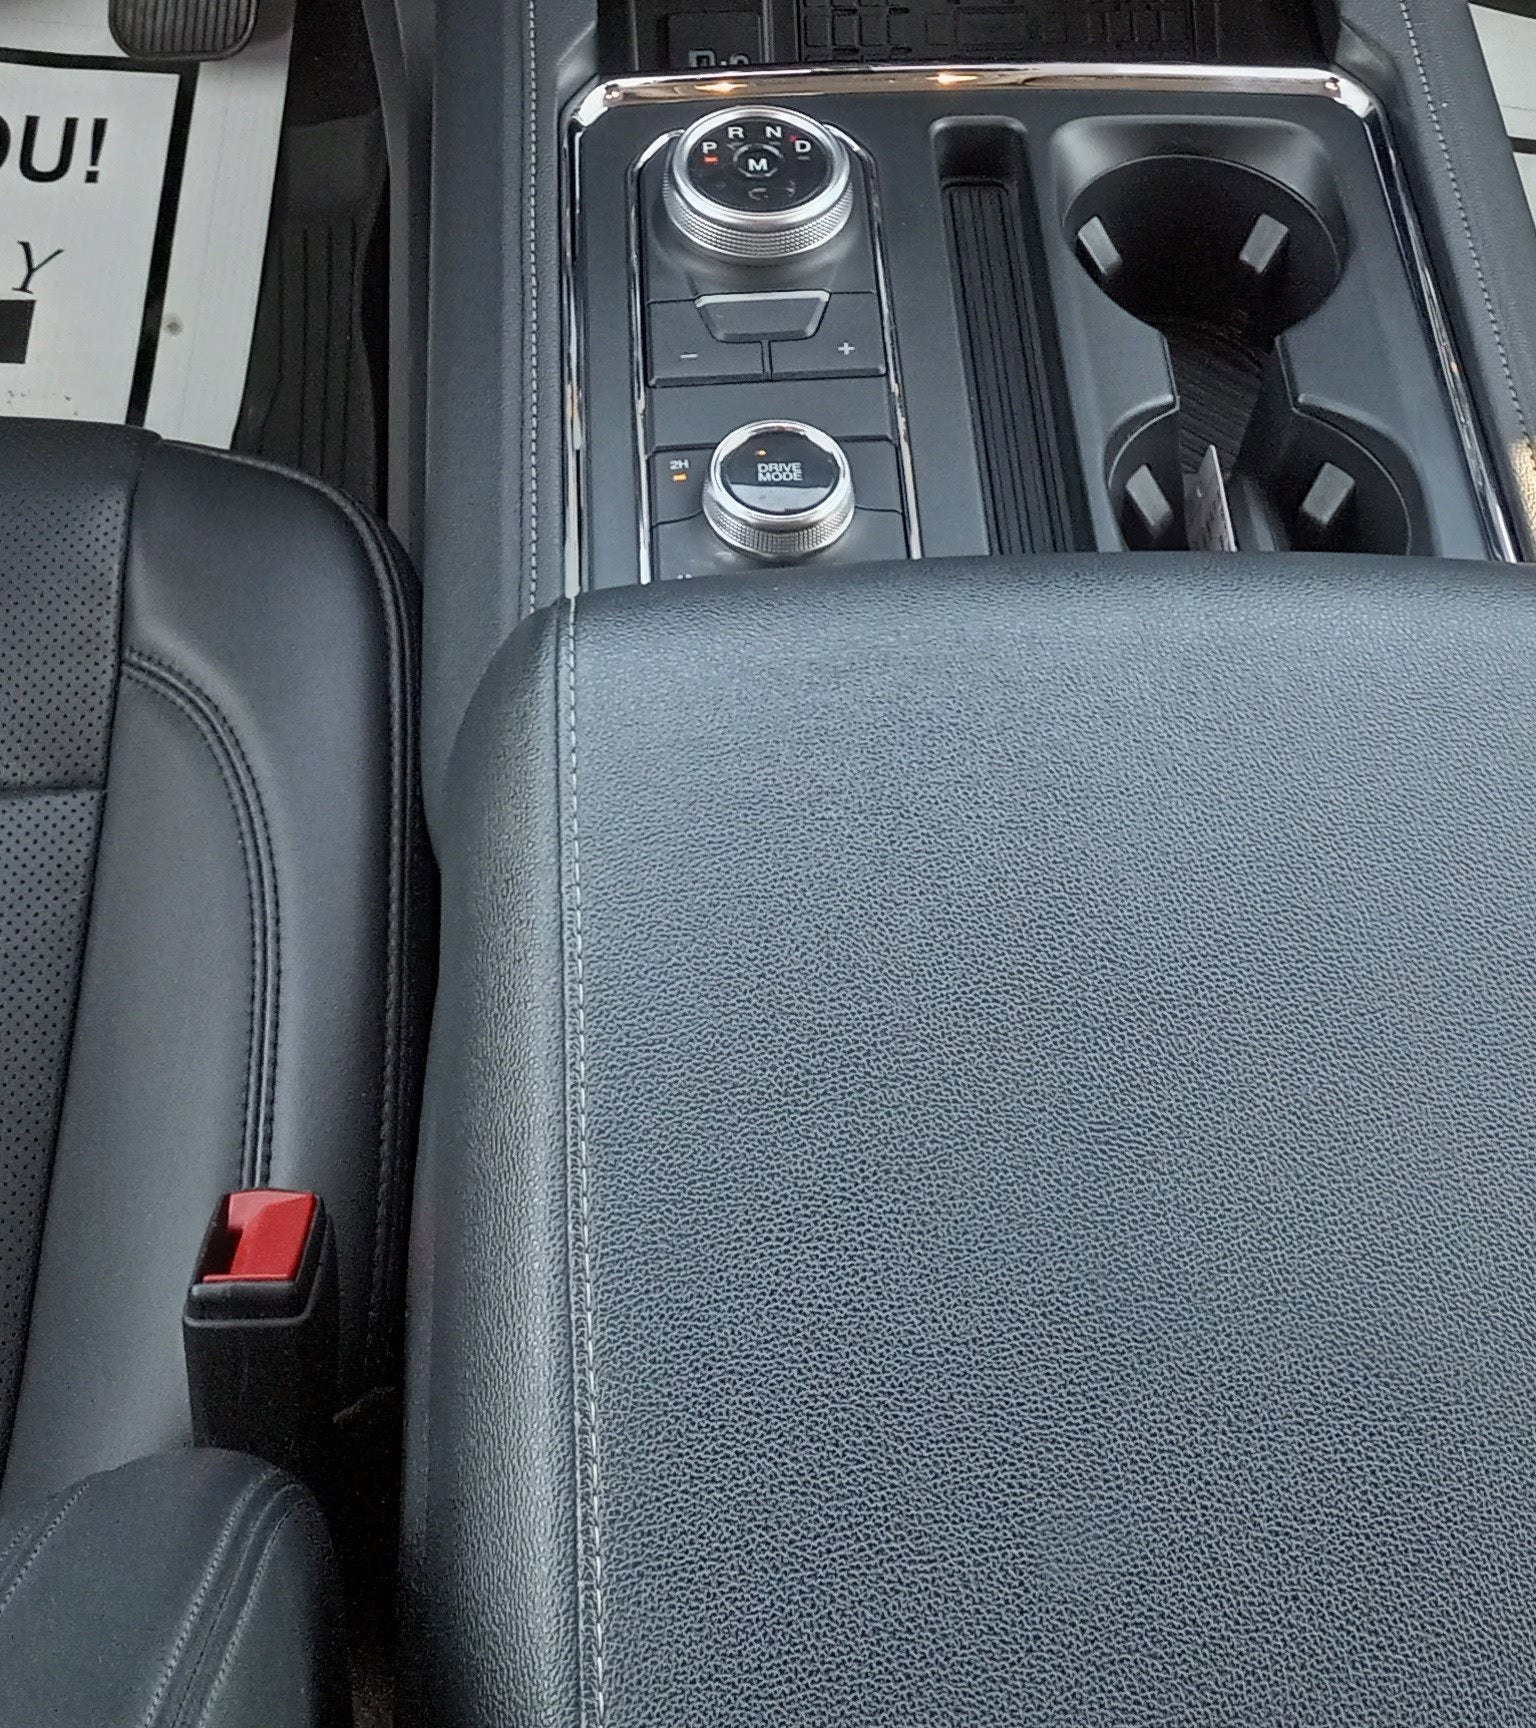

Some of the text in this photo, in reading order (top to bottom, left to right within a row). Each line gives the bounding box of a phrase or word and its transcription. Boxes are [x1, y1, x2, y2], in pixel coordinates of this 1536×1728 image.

[727, 126, 745, 139] R
[765, 126, 782, 138] N
[702, 141, 718, 154] P
[795, 139, 812, 153] D
[747, 158, 768, 171] M
[669, 459, 689, 470] 2H
[756, 462, 802, 475] DRIVE
[757, 471, 803, 483] MODE
